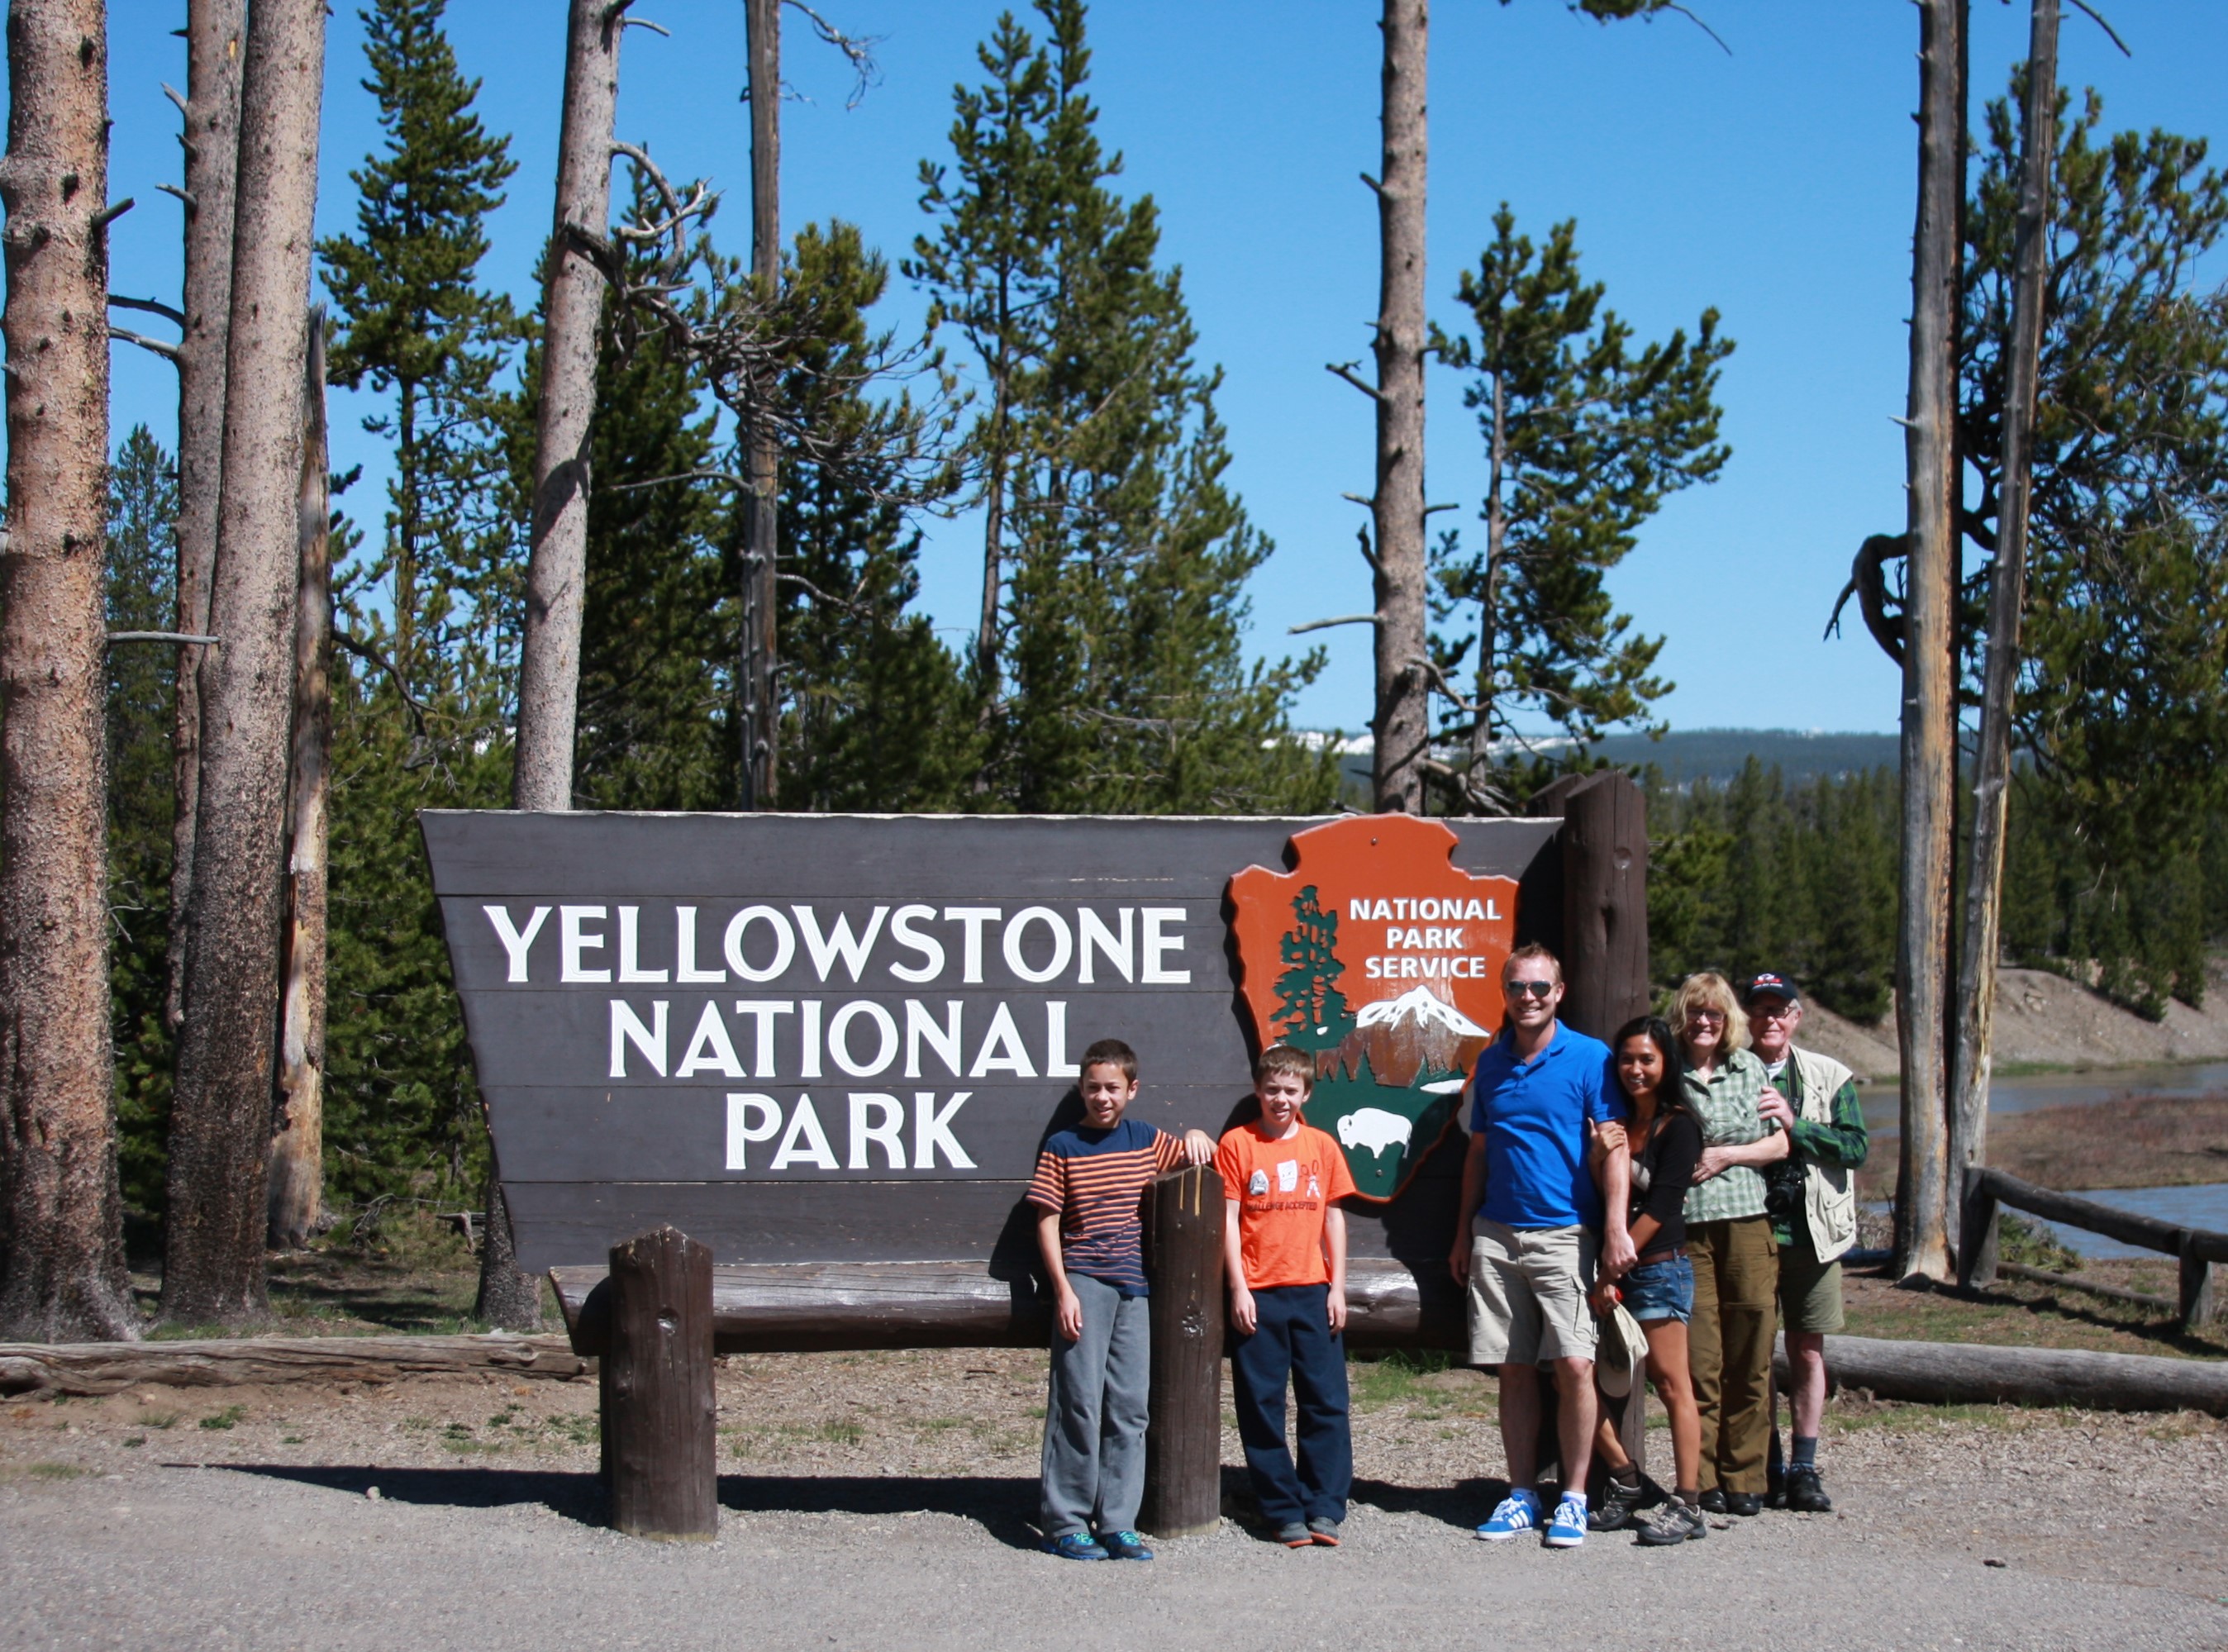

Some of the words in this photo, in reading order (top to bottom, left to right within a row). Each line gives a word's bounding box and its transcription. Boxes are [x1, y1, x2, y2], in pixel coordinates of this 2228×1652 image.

[1350, 898, 1502, 921] NATIONAL
[483, 904, 1191, 983] YELLOWSTONE
[1387, 927, 1464, 950] PARK
[1365, 956, 1486, 978] SERVICE
[610, 999, 1080, 1078] NATIONAL
[726, 1092, 978, 1169] PARK
[1285, 1201, 1317, 1211] ACCEPTED
